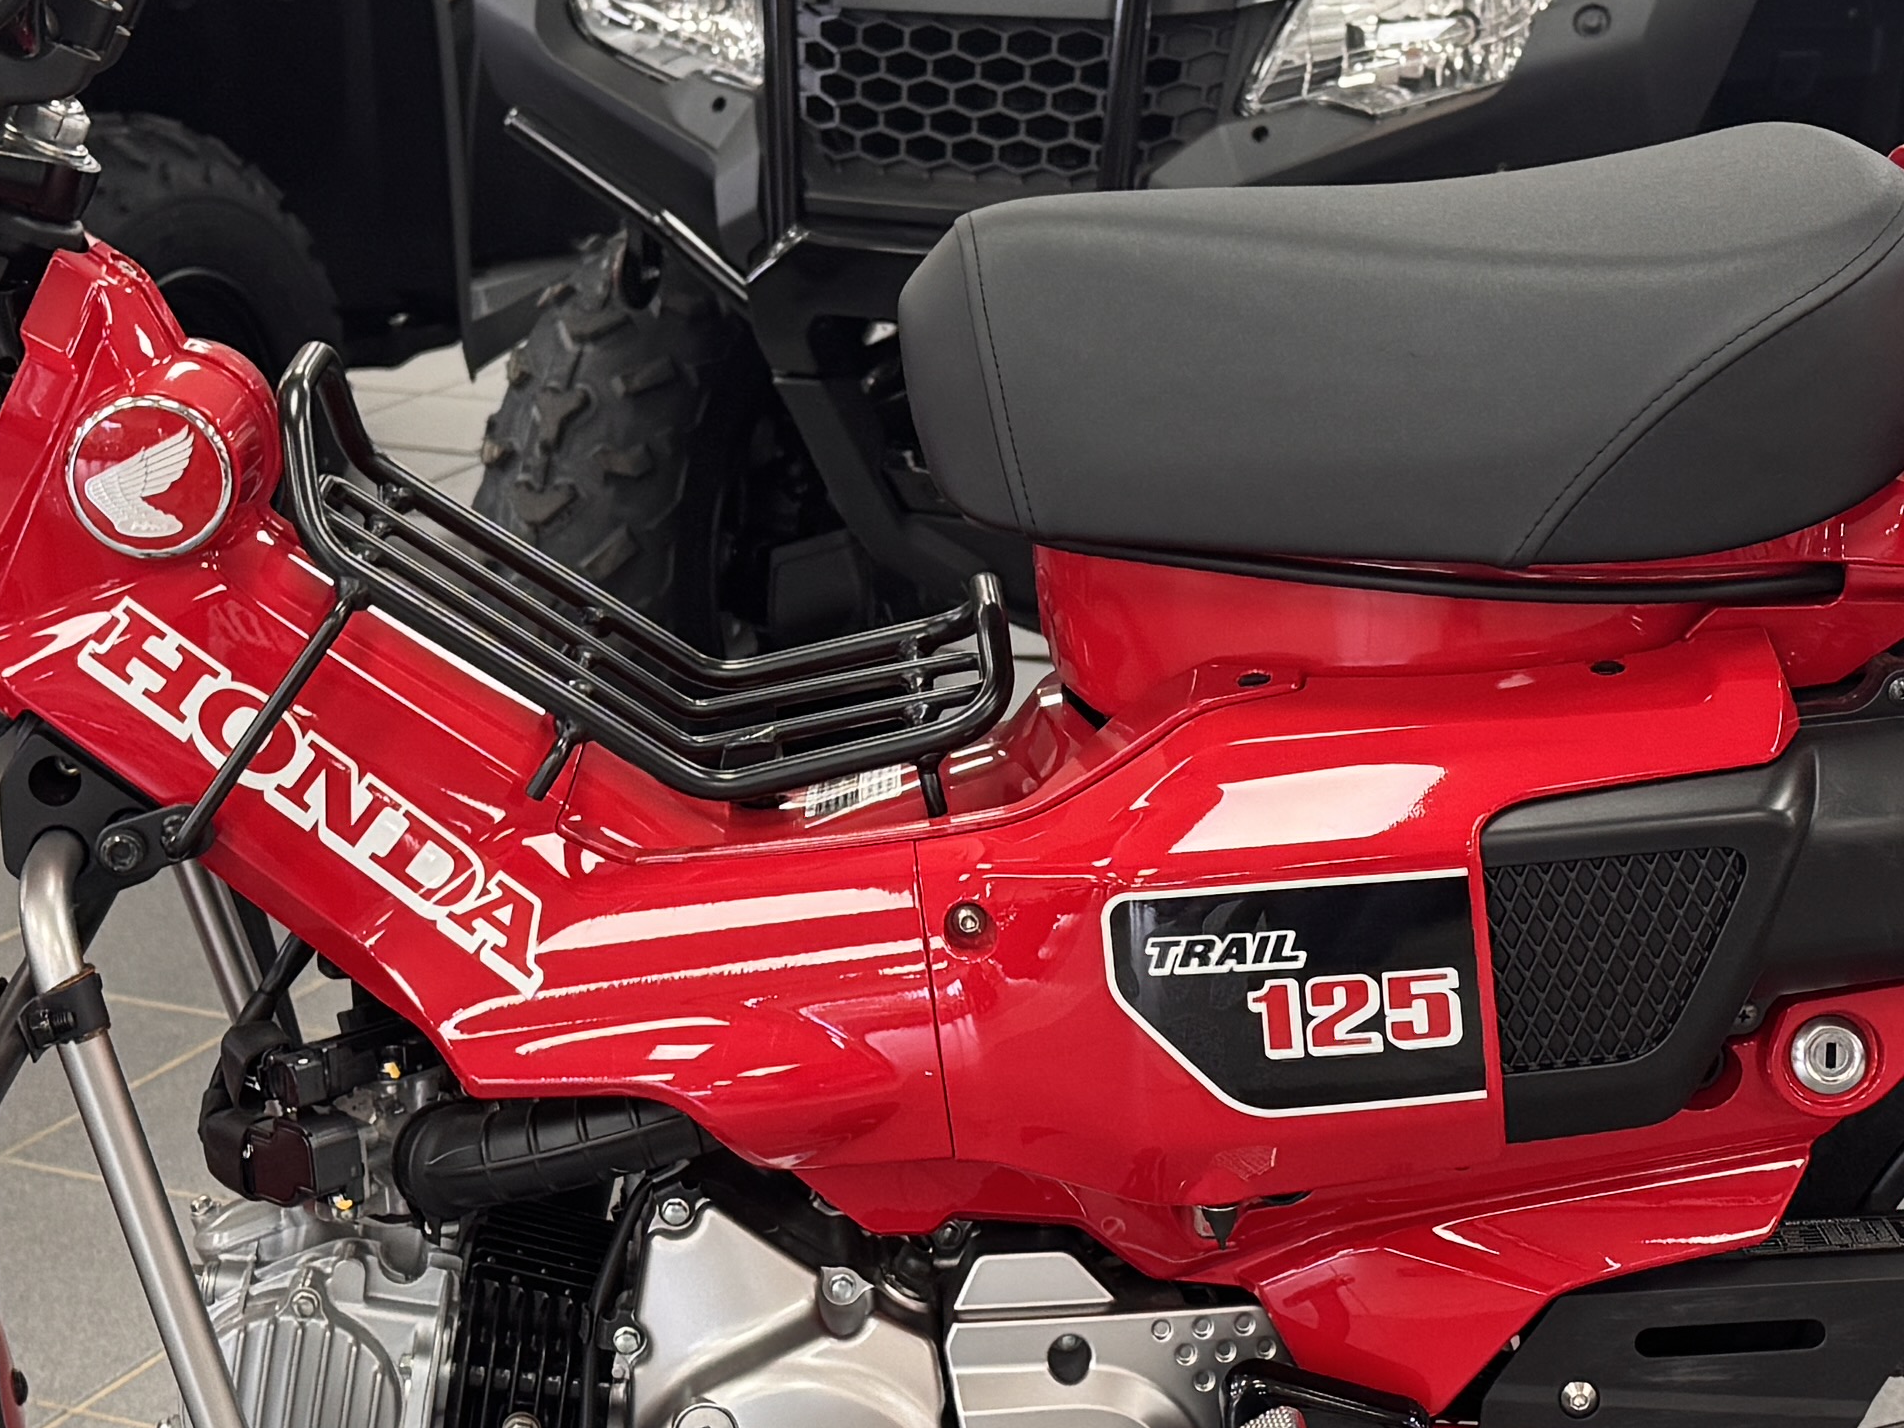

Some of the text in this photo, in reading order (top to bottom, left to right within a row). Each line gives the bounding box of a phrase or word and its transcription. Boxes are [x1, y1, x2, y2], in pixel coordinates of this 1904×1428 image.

[77, 596, 544, 999] HONDA
[1145, 930, 1307, 976] TRAIL
[1247, 967, 1463, 1060] 125
